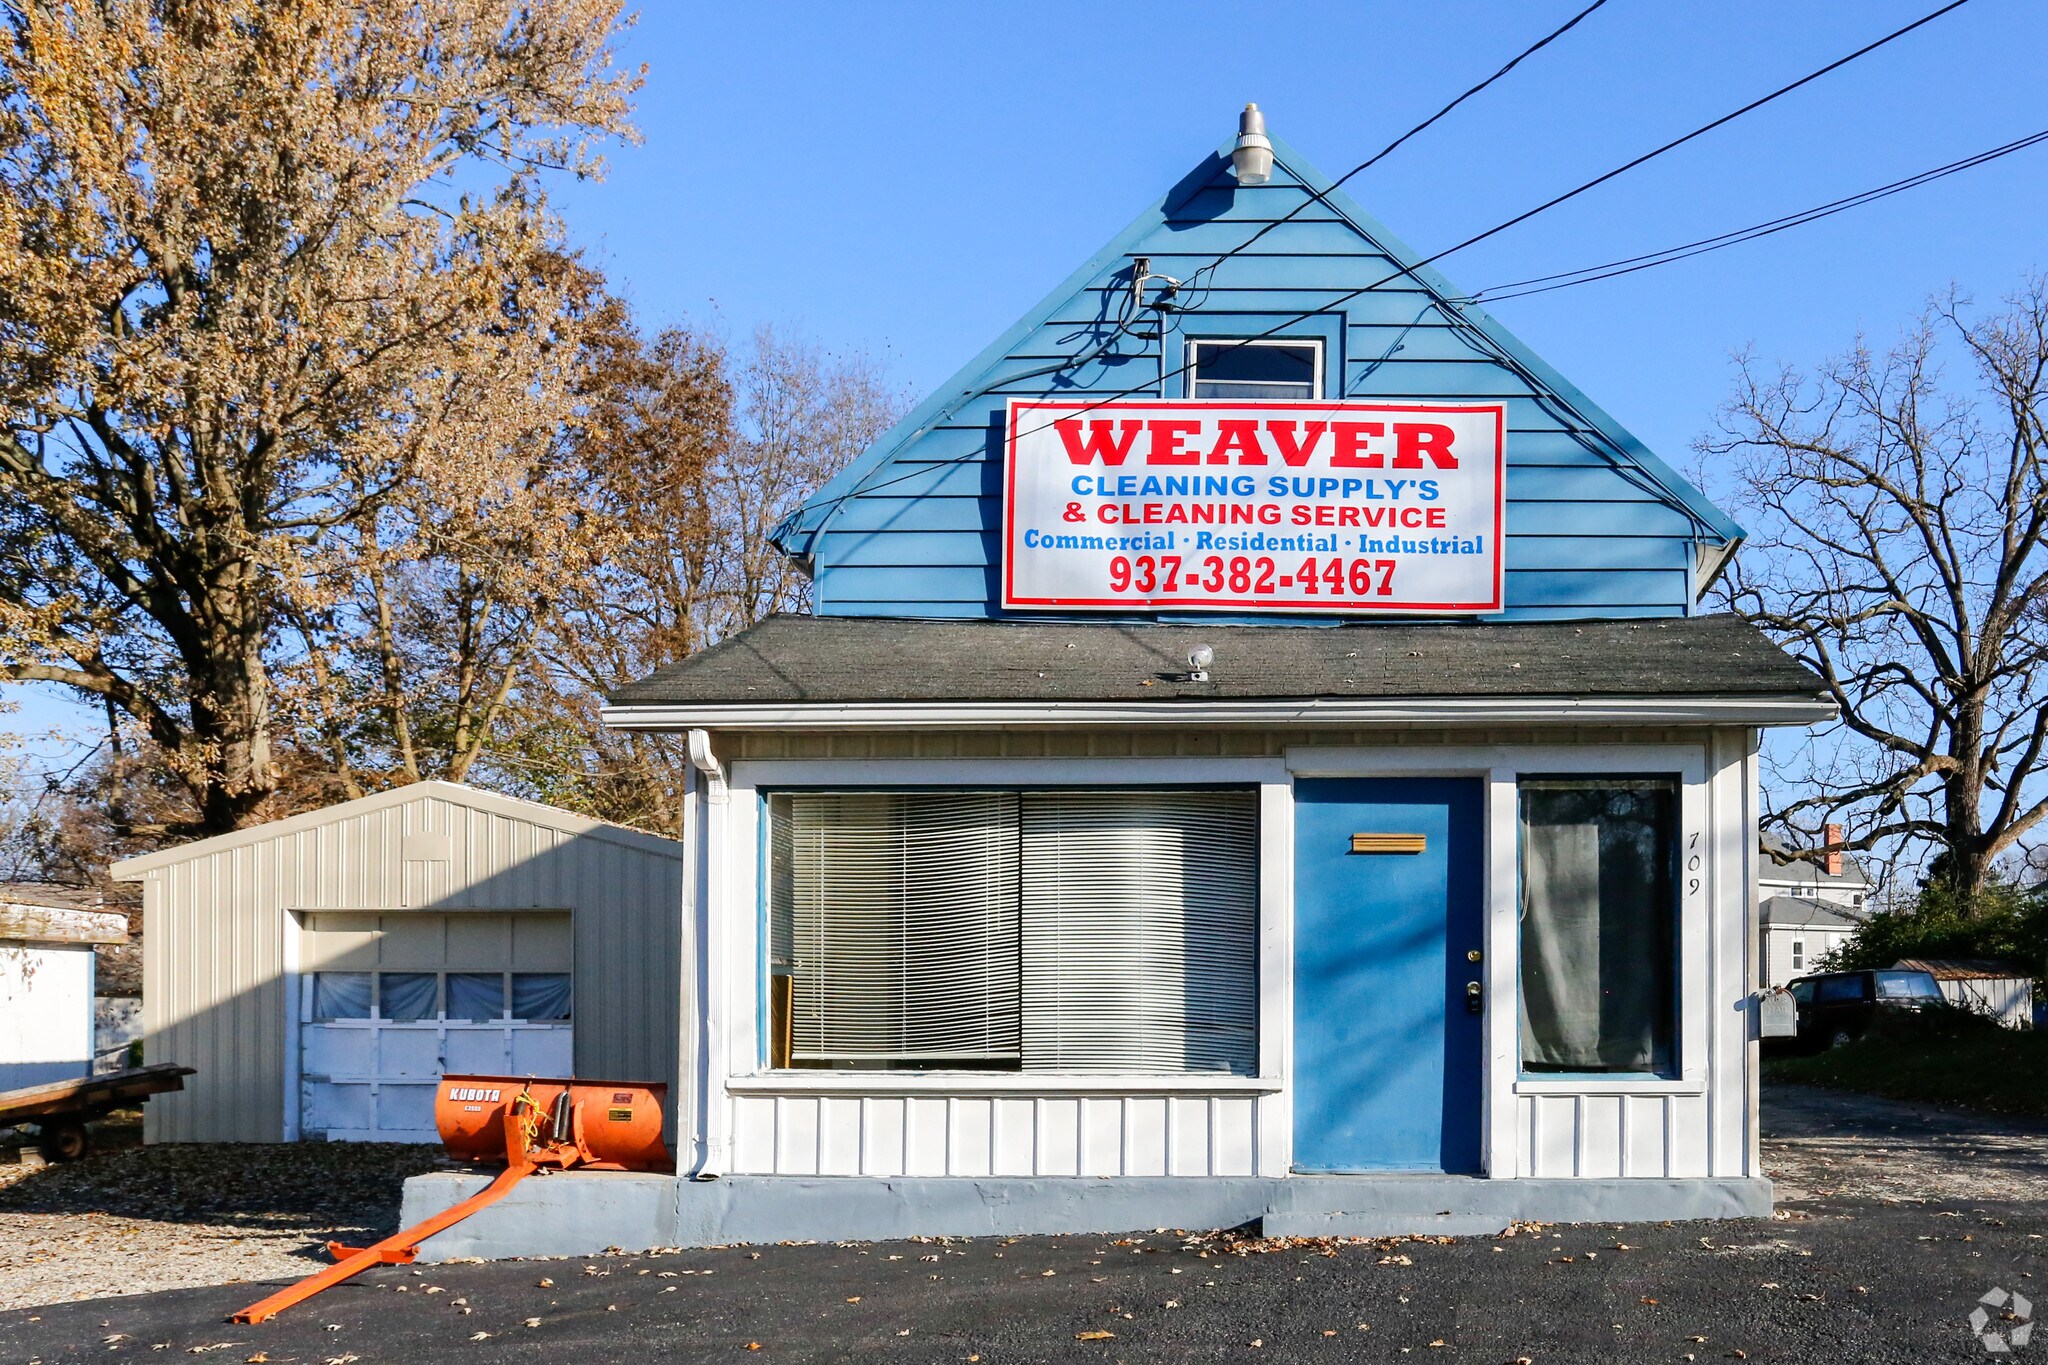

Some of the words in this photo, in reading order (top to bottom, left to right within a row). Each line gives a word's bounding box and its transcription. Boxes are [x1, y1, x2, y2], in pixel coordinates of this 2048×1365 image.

[1053, 418, 1459, 470] WEAVER
[1071, 474, 1256, 497] CLEANING
[1267, 475, 1440, 501] SUPPLY'S
[1062, 501, 1087, 523] &
[1097, 503, 1282, 525] CLEANING
[1291, 504, 1446, 529] SERVICE
[1024, 528, 1175, 552] Commercial
[1196, 530, 1338, 553] Residential
[1359, 534, 1484, 555] Industrial
[1109, 555, 1397, 596] 937-382-4467
[1687, 830, 1701, 897] 709
[449, 1088, 501, 1102] KUBOTA
